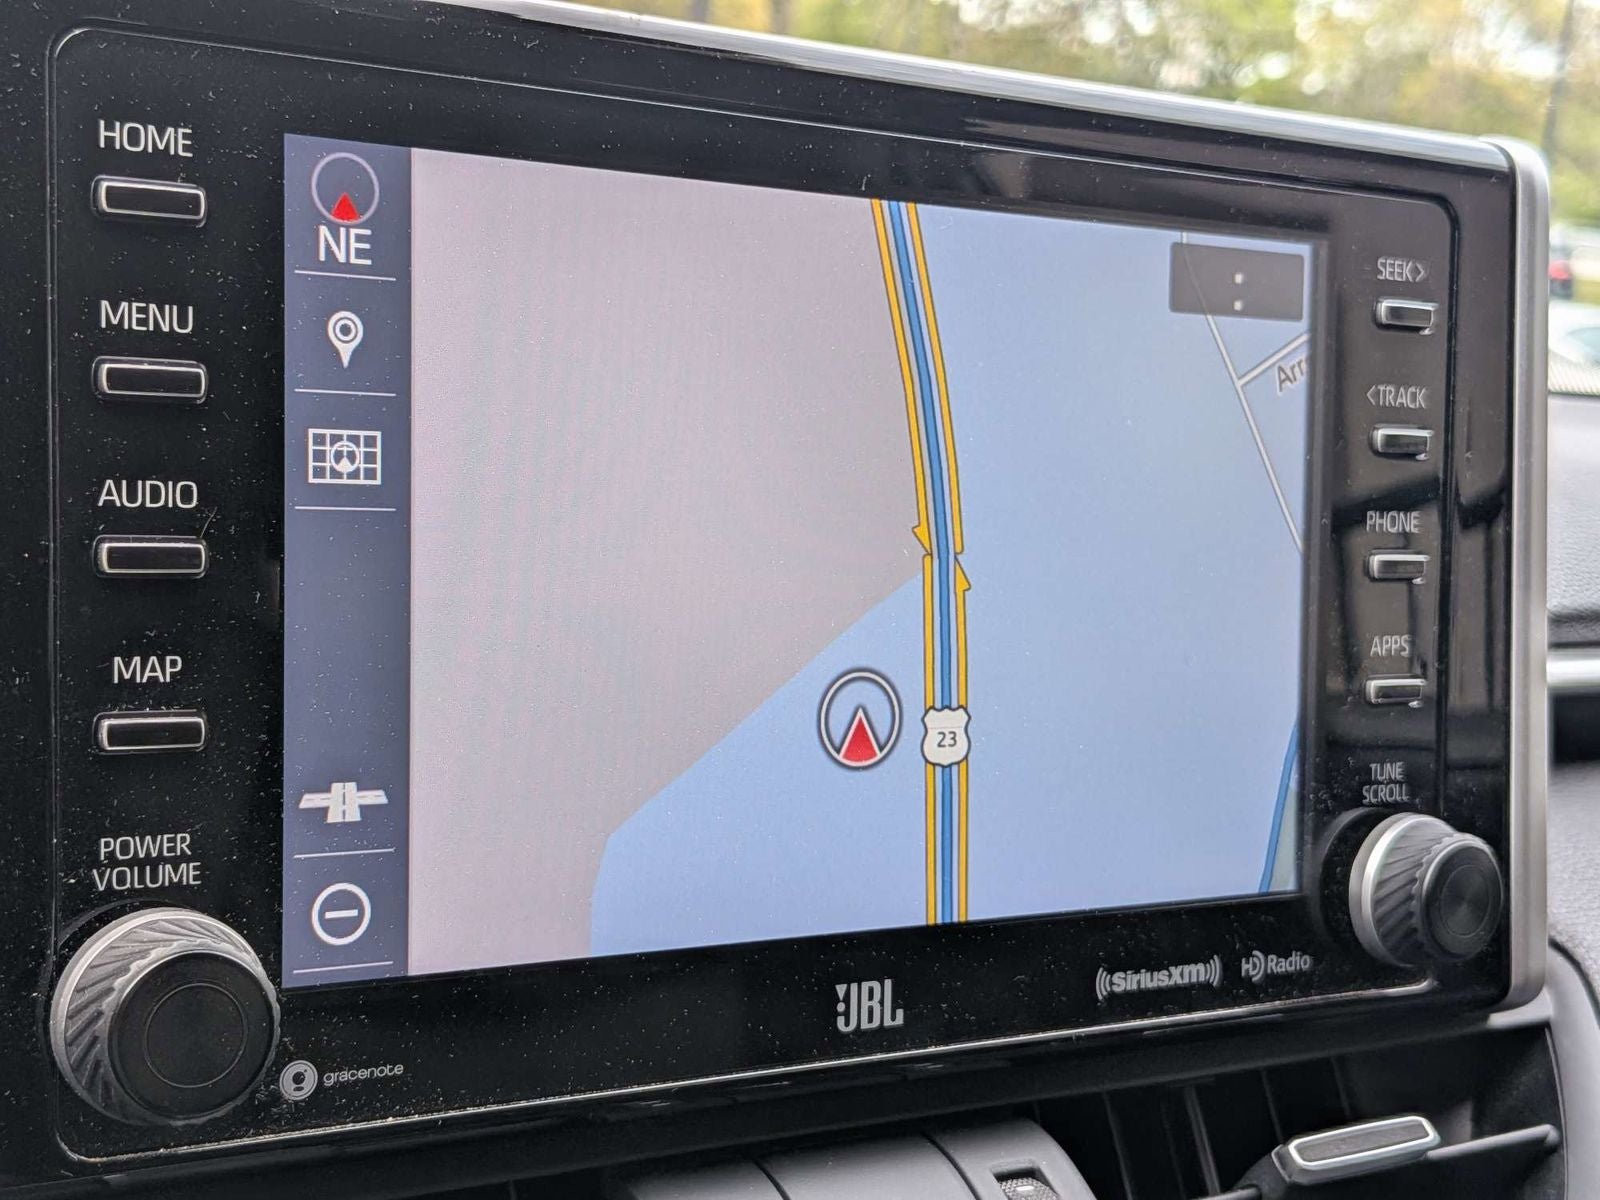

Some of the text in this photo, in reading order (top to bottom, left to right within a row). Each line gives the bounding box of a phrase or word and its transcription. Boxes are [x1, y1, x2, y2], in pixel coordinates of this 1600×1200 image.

[98, 119, 193, 157] HOME
[317, 224, 373, 266] NE
[1377, 257, 1413, 281] SEEK
[99, 300, 194, 334] MENU
[1378, 386, 1427, 409] TRACK
[98, 479, 198, 509] AUDIO
[1365, 511, 1421, 534] PHONE
[1369, 634, 1411, 658] APPS
[112, 656, 183, 684] MAP
[937, 731, 957, 748] 23
[1369, 761, 1405, 782] TUNE
[1361, 784, 1409, 804] SCROLL
[99, 833, 192, 861] POWER
[92, 862, 202, 891] VOLUME
[1266, 951, 1311, 974] Radio
[836, 979, 904, 1033] JBL
[323, 1064, 404, 1087] gracenote
